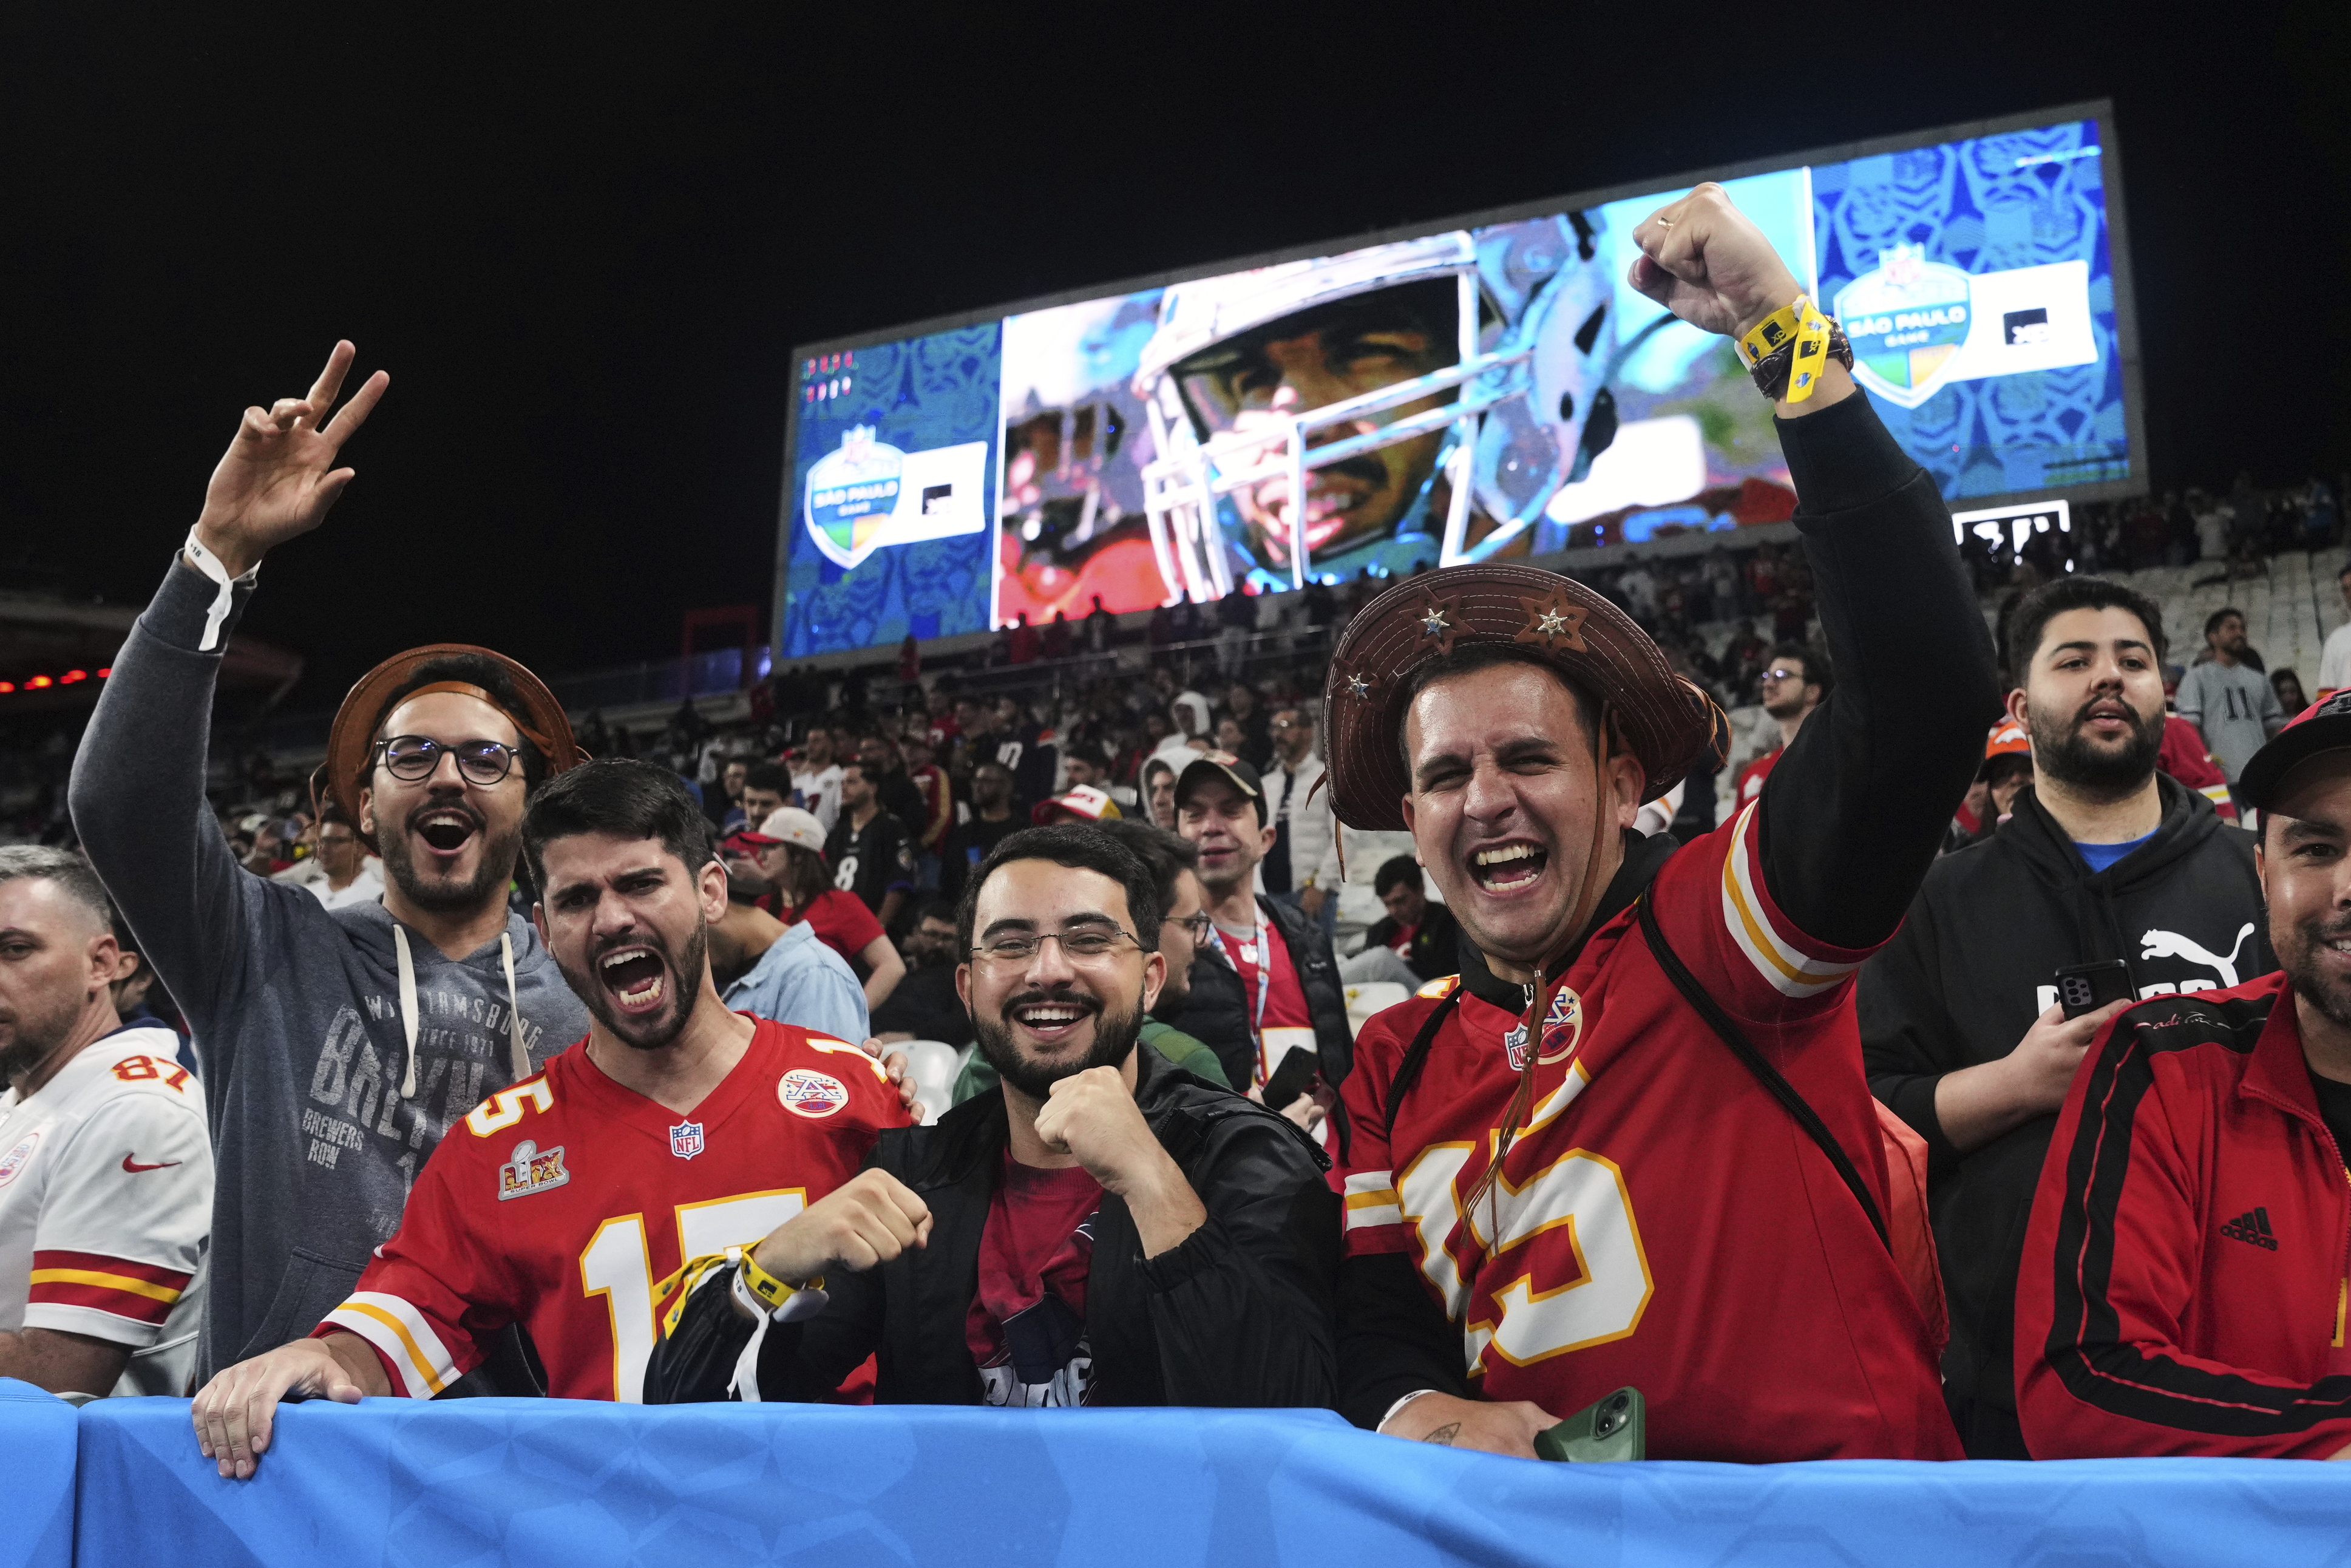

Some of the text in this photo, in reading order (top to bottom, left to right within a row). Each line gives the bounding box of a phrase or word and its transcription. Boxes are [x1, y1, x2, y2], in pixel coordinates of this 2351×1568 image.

[1895, 305, 1966, 331] PAULO
[364, 991, 543, 1050] WIIAMSBURG
[110, 1055, 190, 1095] 87
[302, 1108, 364, 1152] BREWERS
[675, 1136, 699, 1153] NFL
[308, 1138, 341, 1170] ROW
[511, 1177, 559, 1193] SUPER BOWL
[2220, 1225, 2278, 1251] adidas
